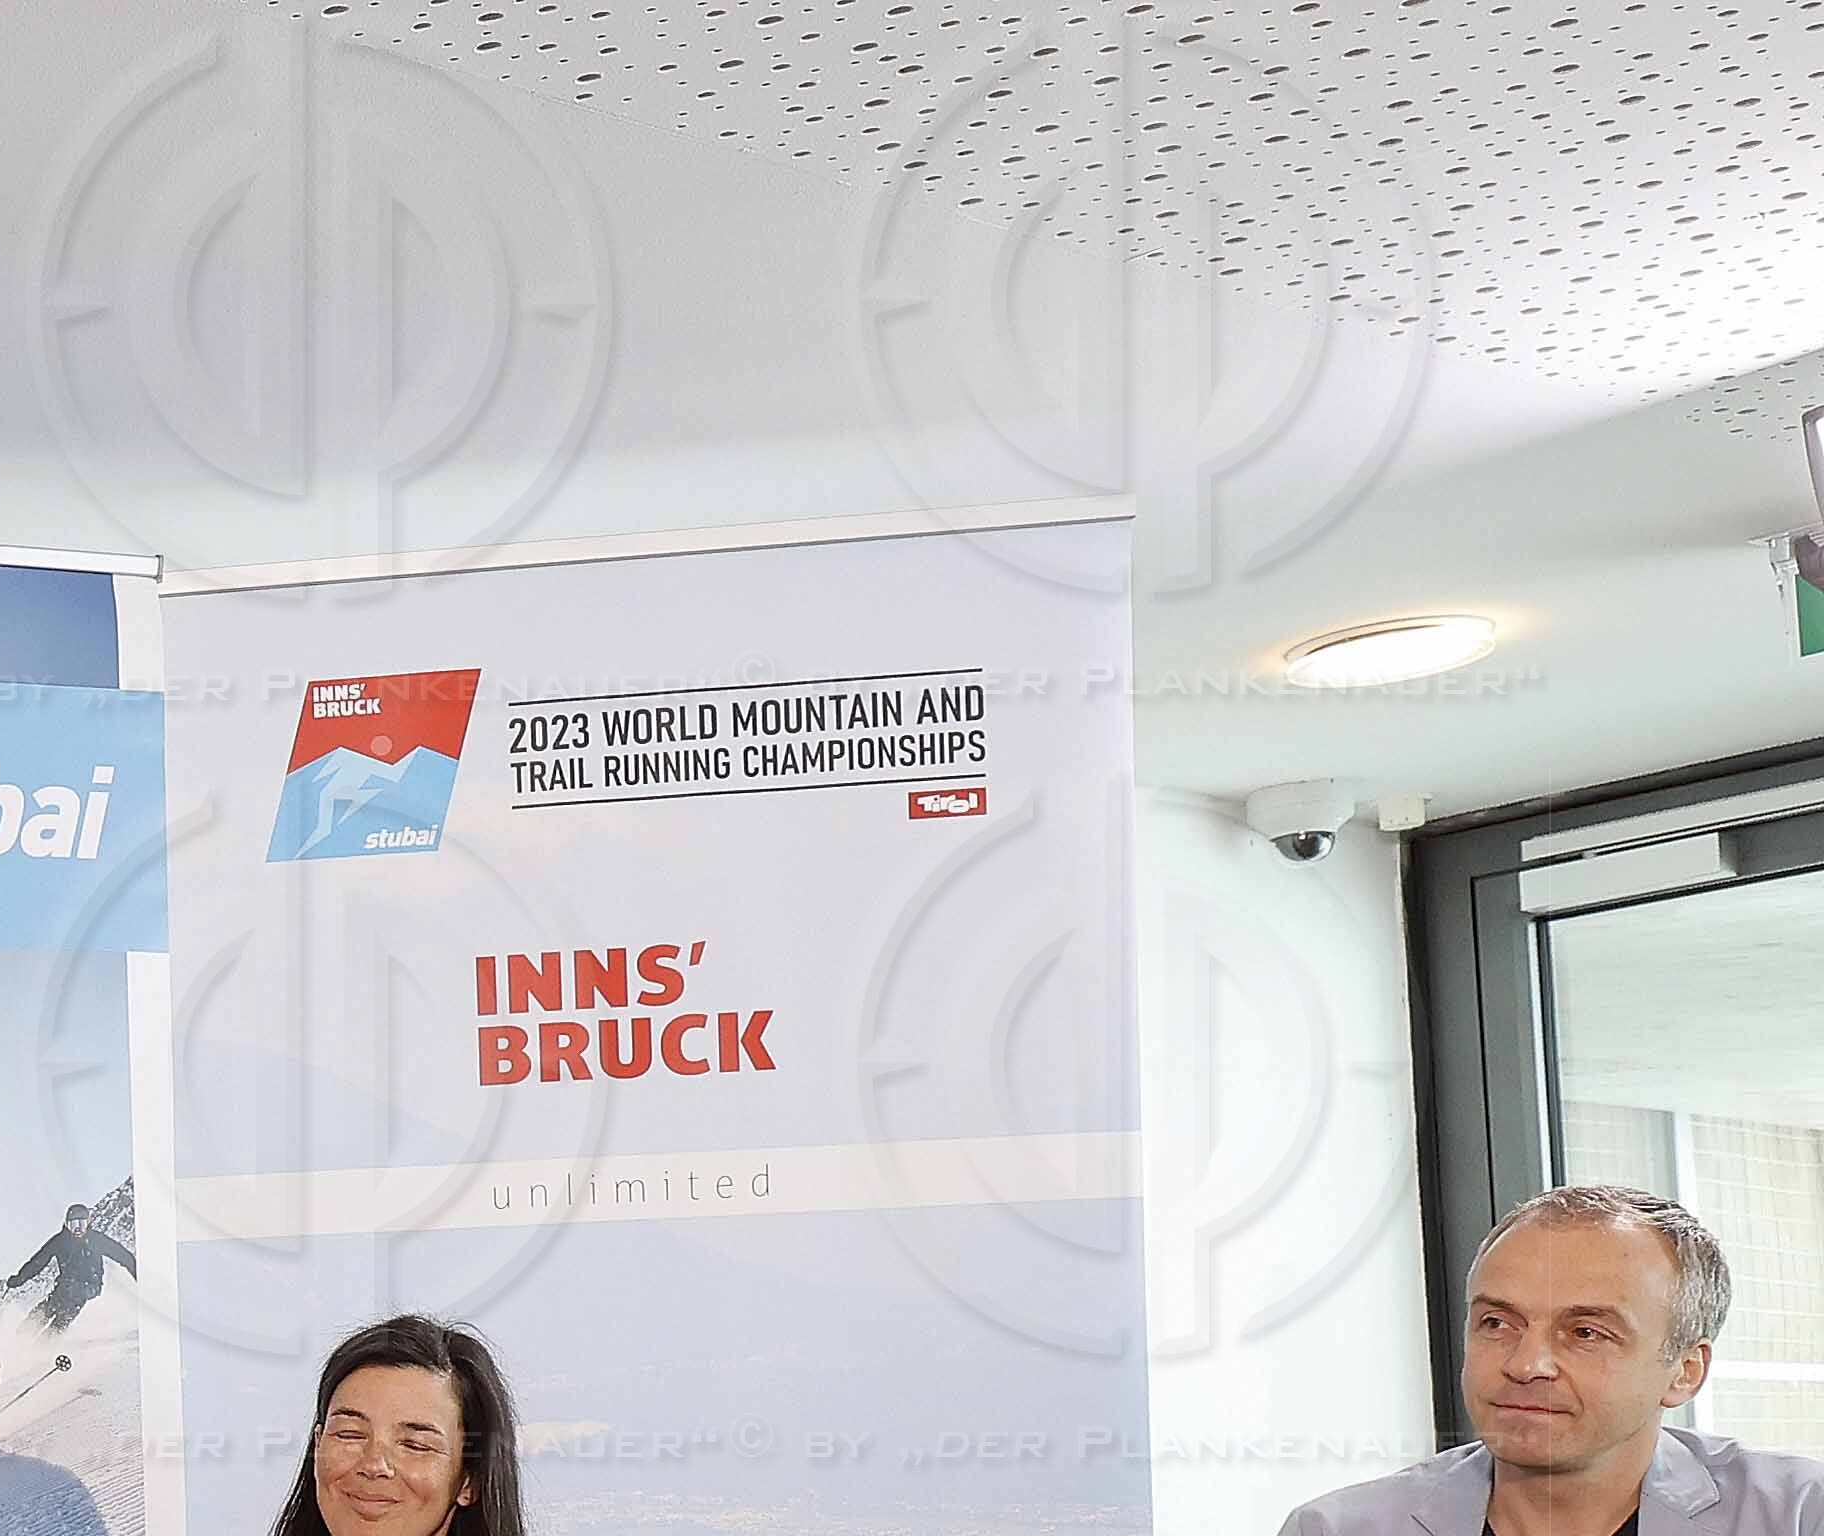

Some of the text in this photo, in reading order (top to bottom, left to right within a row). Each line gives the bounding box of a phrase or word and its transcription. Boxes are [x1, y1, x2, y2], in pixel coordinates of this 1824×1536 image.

[313, 697, 381, 719] BRUCK
[508, 684, 986, 754] 2023 WORLD MOUNTAIN AND
[510, 730, 987, 794] TRAIL RUNNING CHAMPIONSHIPS
[916, 792, 978, 814] Tirol
[363, 824, 440, 850] stubai
[478, 1010, 776, 1086] BRUCK
[492, 1162, 771, 1210] unlimited
